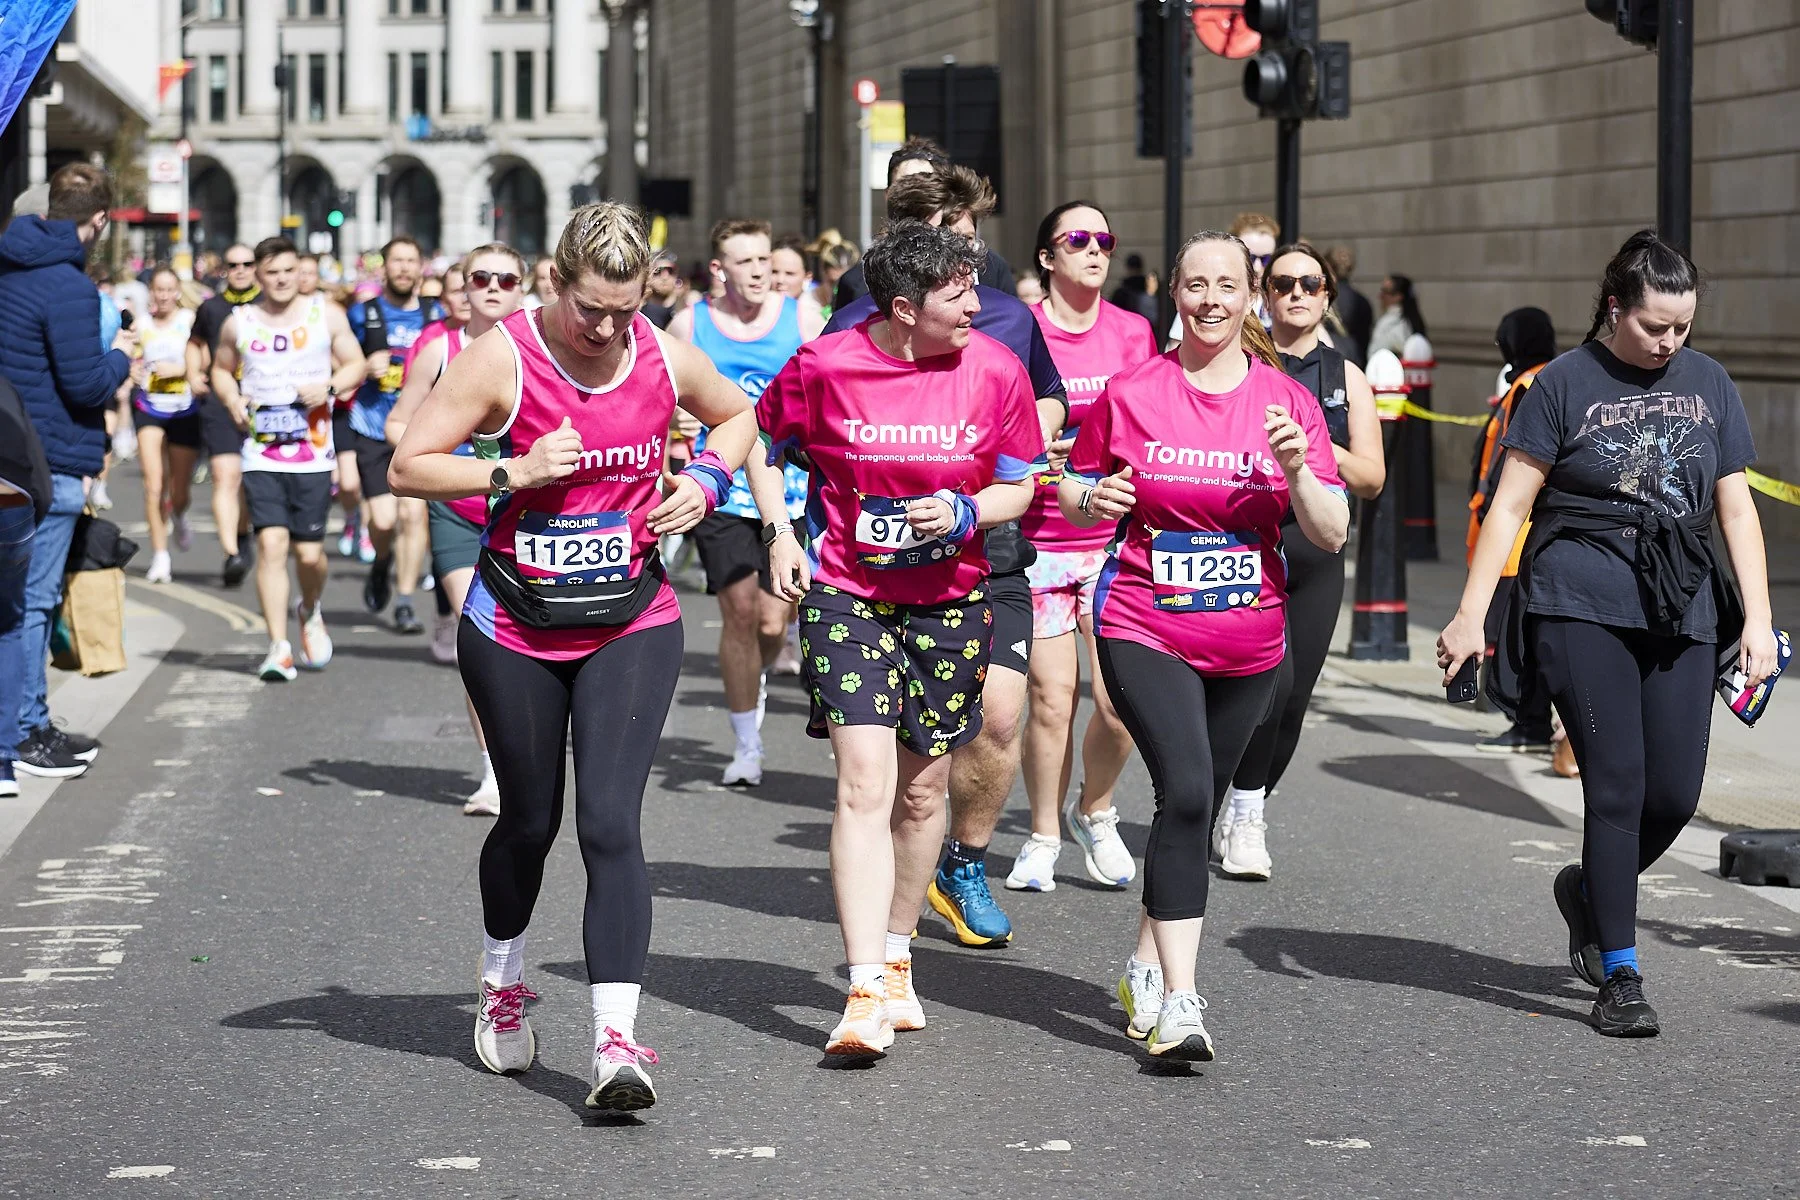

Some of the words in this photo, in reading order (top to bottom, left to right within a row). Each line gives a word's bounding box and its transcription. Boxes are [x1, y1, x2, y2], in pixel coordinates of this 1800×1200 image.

[843, 418, 978, 451] Tommy's
[574, 435, 662, 471] mmy's
[844, 452, 858, 461] The
[859, 453, 905, 463] pregnancy
[907, 453, 925, 462] and
[926, 453, 949, 464] baby
[1143, 440, 1275, 478] Tommy's
[1139, 471, 1153, 480] The
[1153, 473, 1201, 485] pregnancy
[1202, 477, 1220, 486] and
[1221, 478, 1245, 490] baby
[547, 517, 599, 530] CAROLINE
[524, 536, 625, 567] 11236
[1190, 536, 1228, 545] GEMMA
[1161, 554, 1256, 582] 11235
